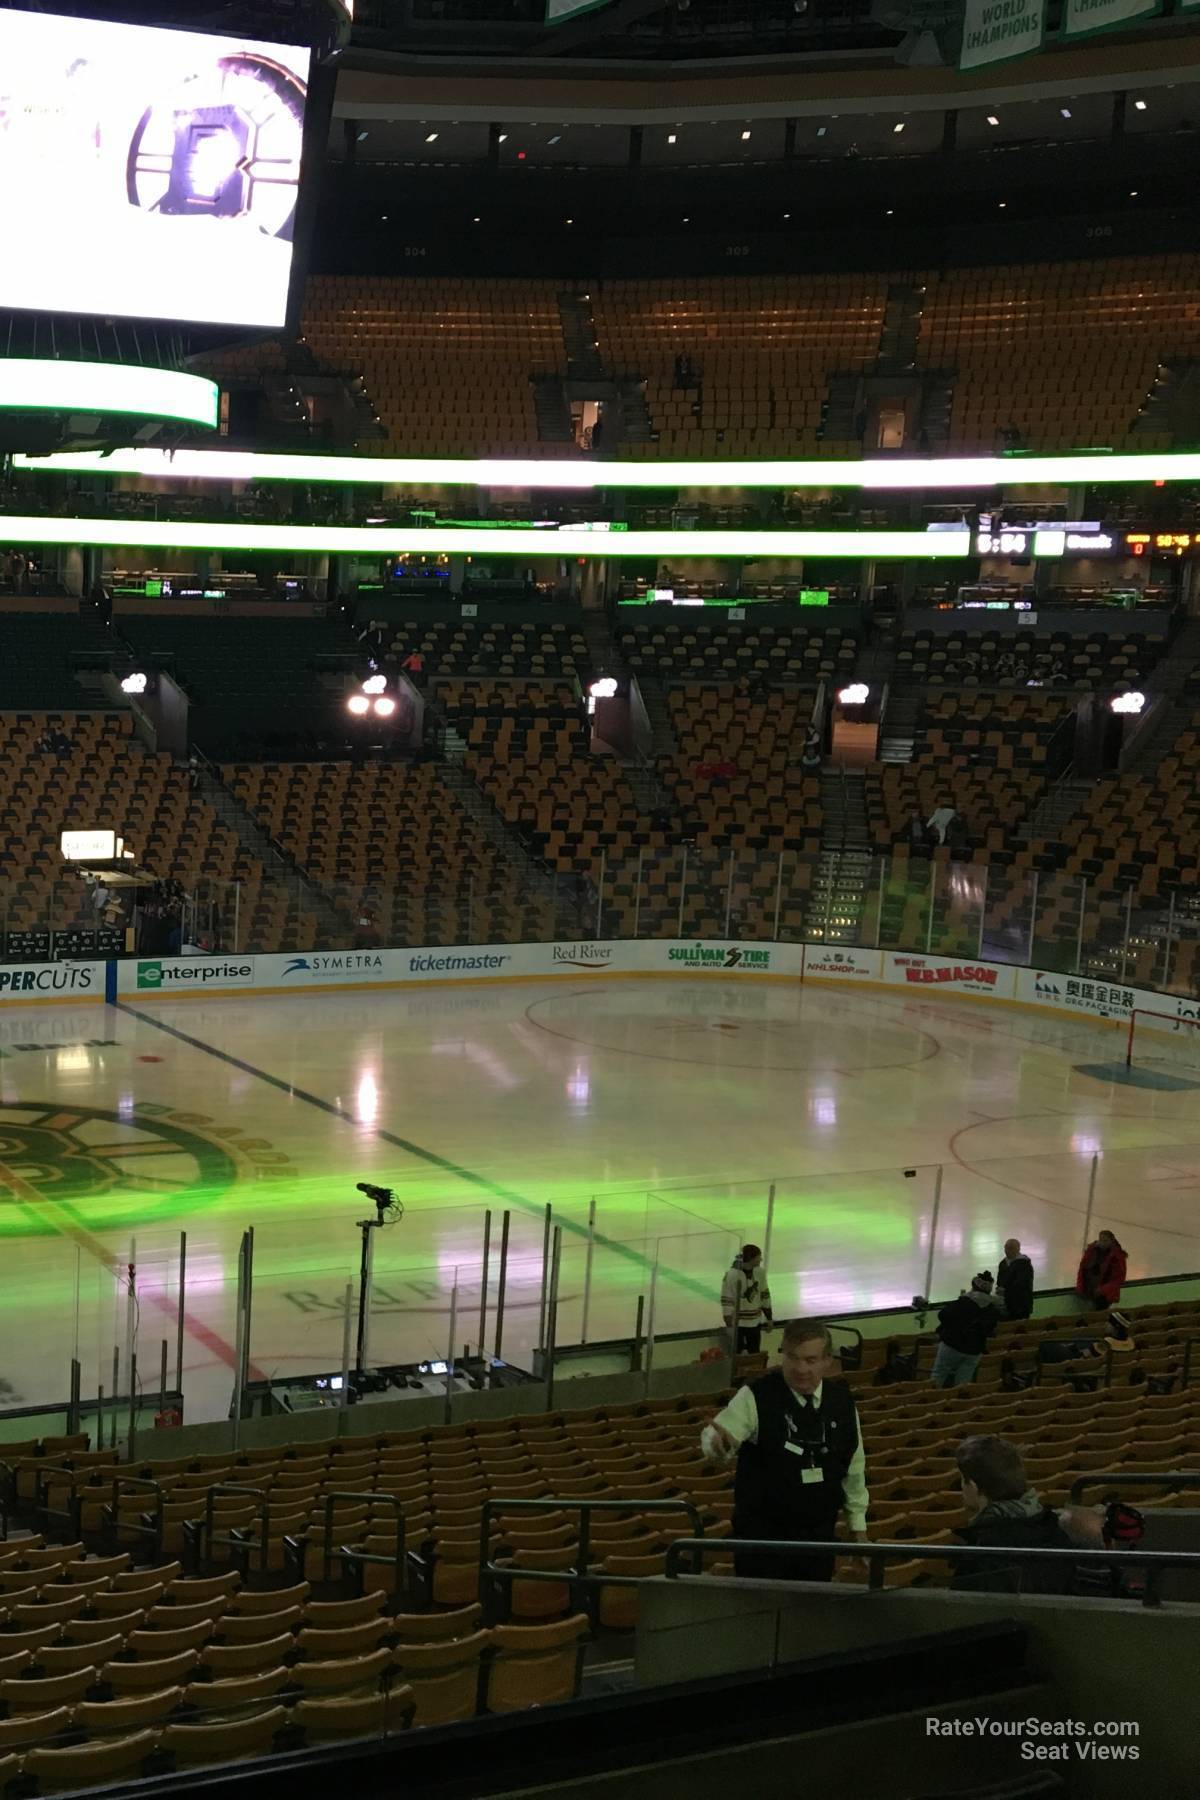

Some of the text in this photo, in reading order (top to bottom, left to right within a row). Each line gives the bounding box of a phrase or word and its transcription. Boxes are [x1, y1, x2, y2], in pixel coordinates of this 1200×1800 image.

[982, 0, 1025, 24] WORLD
[967, 13, 1039, 50] CHAMPIONS
[553, 943, 613, 960] Red River
[742, 949, 770, 963] TIRE
[143, 963, 252, 981] enterprise
[313, 956, 383, 970] SYMETRA
[409, 954, 506, 972] ticketmaster
[1065, 980, 1136, 1009] 奥瑞金包装
[1065, 997, 1083, 1007] ORG
